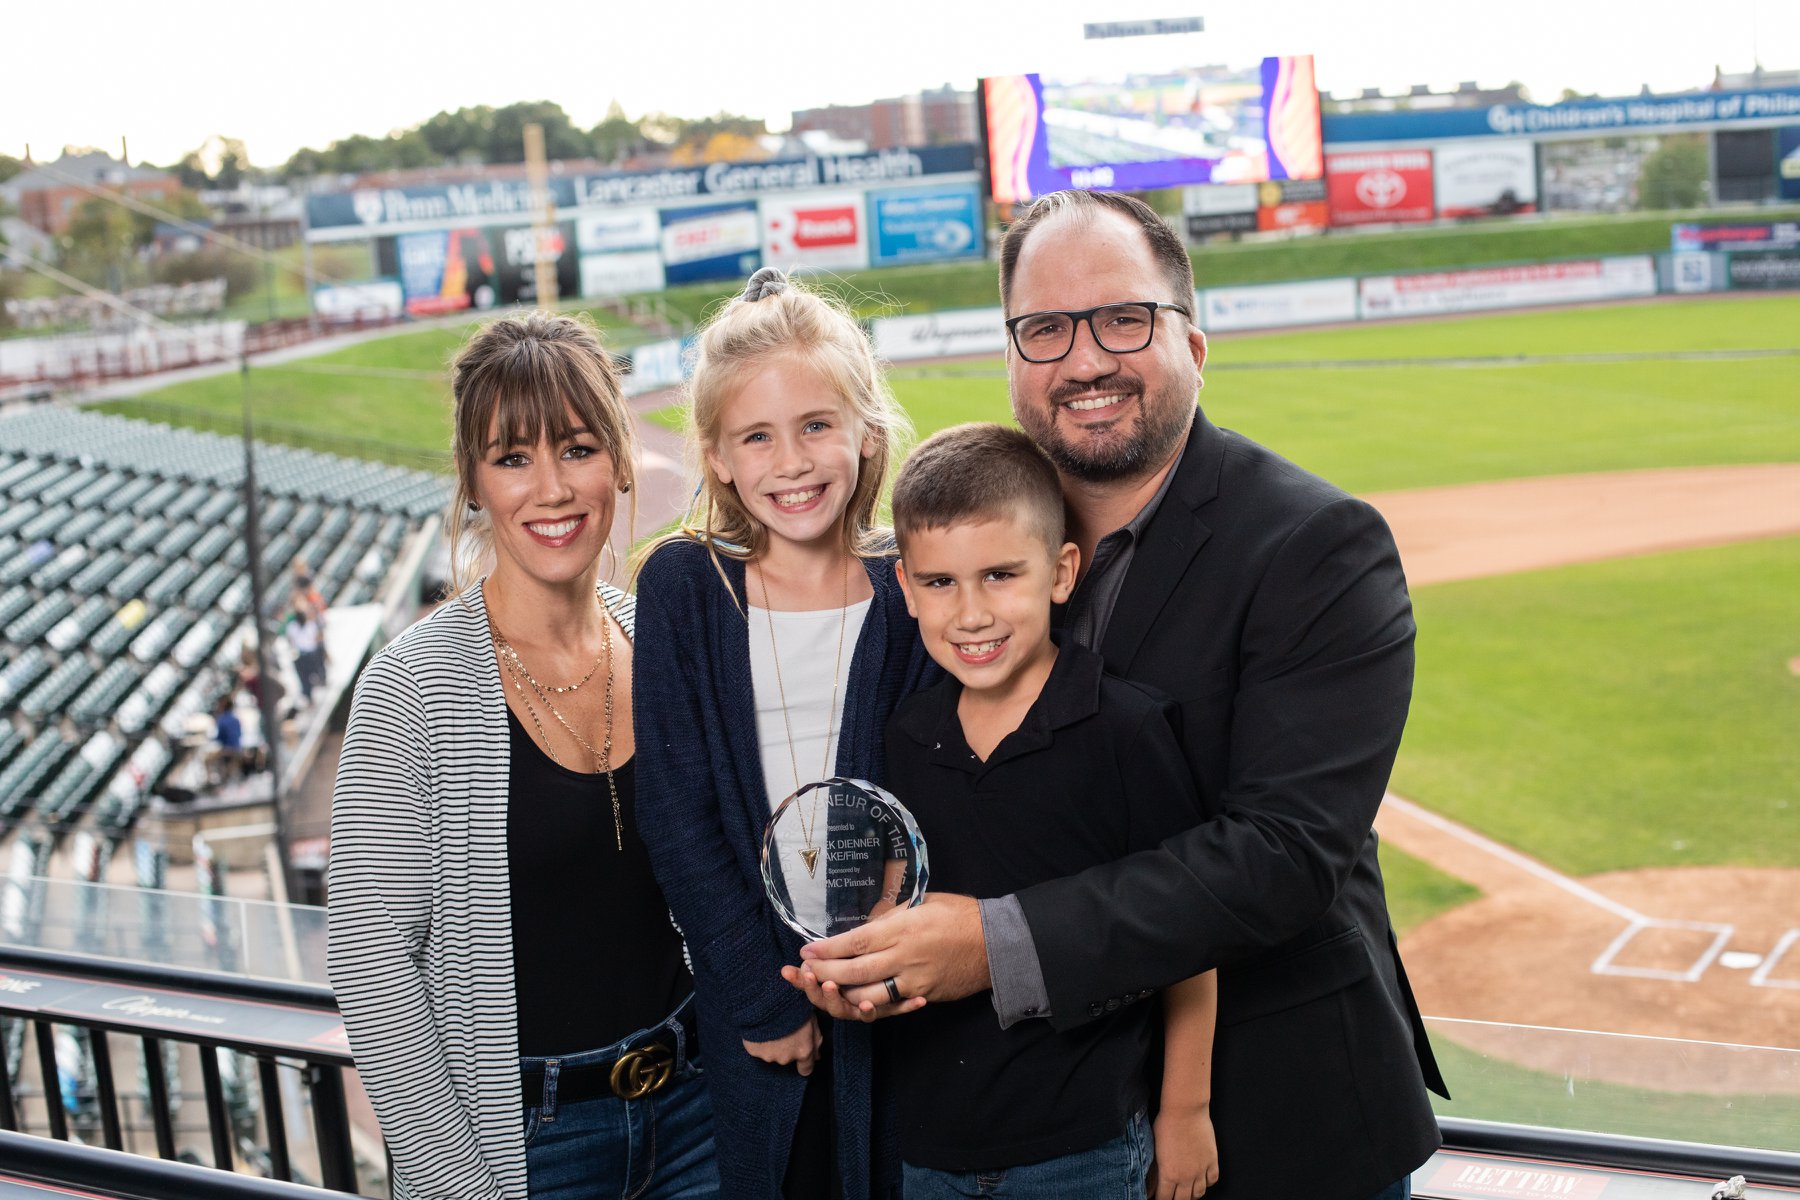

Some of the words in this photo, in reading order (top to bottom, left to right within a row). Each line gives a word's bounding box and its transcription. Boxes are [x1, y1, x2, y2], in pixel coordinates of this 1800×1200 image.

[1716, 95, 1742, 118] of
[574, 171, 701, 205] Lancaster
[704, 158, 818, 194] General
[823, 145, 923, 184] Health
[837, 837, 880, 849] DIENNER
[870, 805, 891, 823] OF
[888, 824, 907, 859] THE
[826, 850, 869, 861] AKE/Films
[844, 876, 875, 888] Pinnacle
[1457, 1165, 1581, 1194] RETTEW
